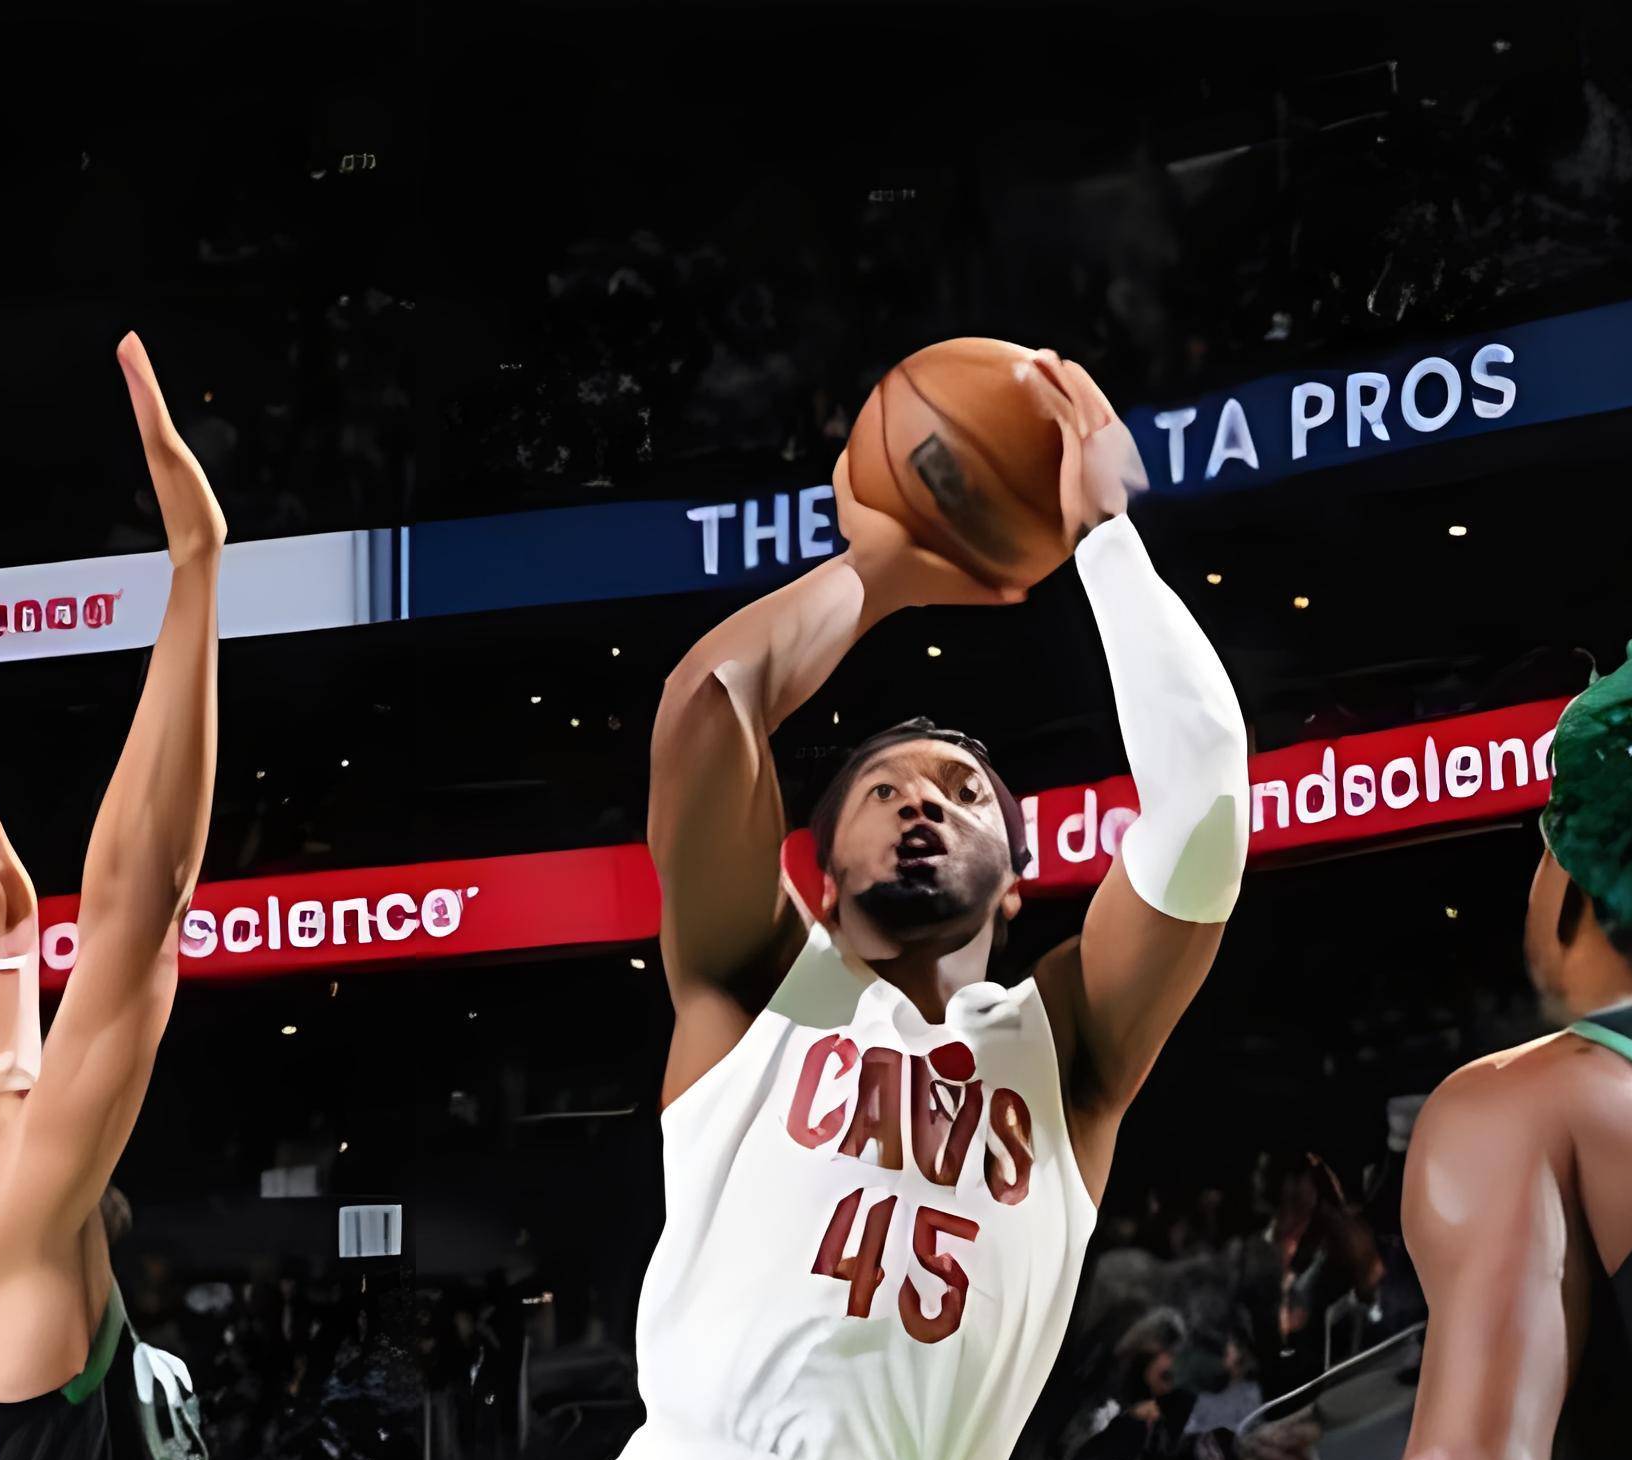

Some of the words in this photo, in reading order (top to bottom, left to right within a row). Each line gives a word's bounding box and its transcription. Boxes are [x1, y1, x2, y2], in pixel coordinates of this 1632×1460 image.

[686, 484, 835, 575] THE
[1154, 397, 1260, 484] TA
[1291, 342, 1517, 460] PROS
[785, 1033, 1035, 1206] CAVS
[810, 1187, 981, 1344] 45
